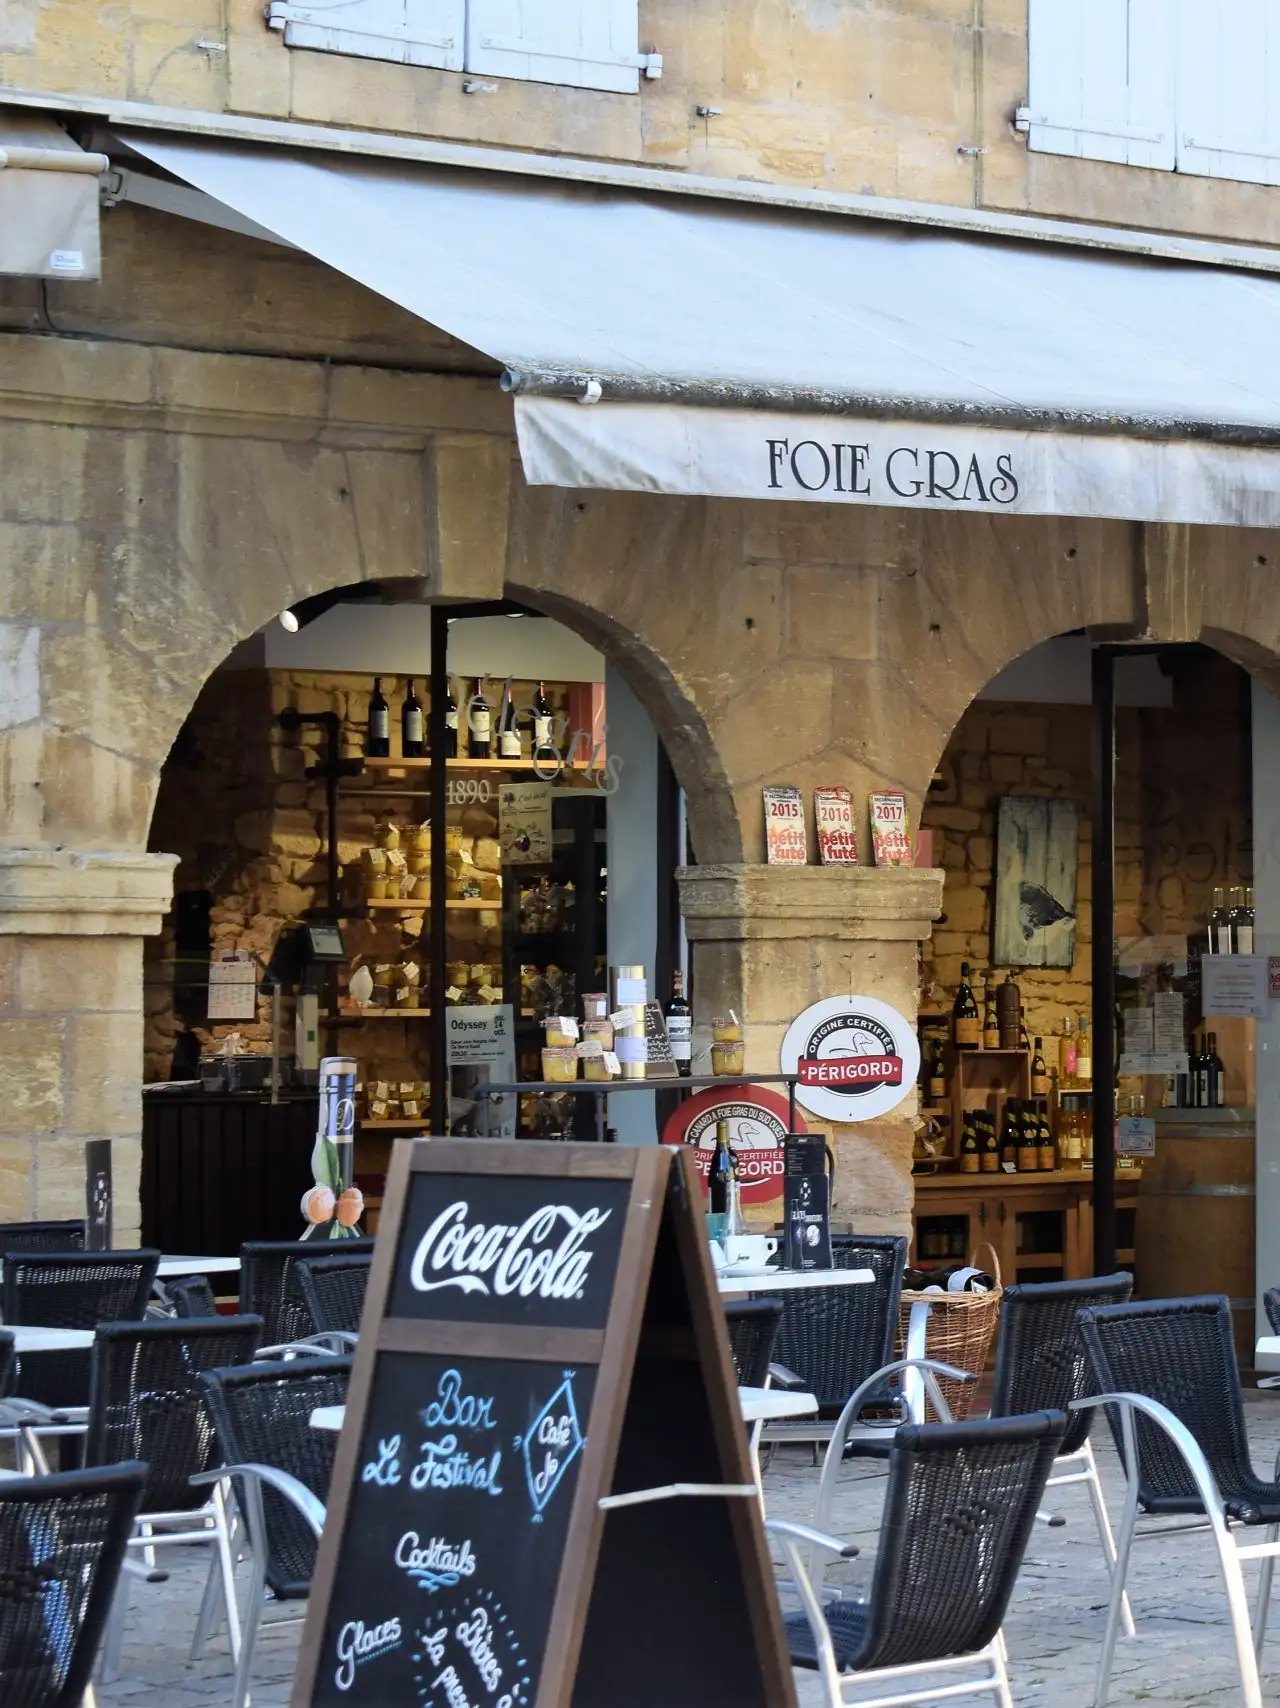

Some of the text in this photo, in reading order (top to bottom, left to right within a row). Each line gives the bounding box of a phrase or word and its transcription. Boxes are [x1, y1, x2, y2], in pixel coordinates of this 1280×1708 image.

[766, 437, 1018, 503] FOIE GRAS
[446, 779, 491, 805] 1890
[771, 802, 798, 817] 2015
[821, 807, 850, 822] 2016
[876, 805, 903, 820] 2017
[828, 845, 858, 860] futé
[451, 1020, 488, 1031] Odyssey
[809, 1018, 893, 1054] ORIGINE CERTIFIÉE
[807, 1061, 893, 1081] PÉRIGORD
[690, 1114, 712, 1138] CANARD
[717, 1107, 732, 1118] FOIE
[732, 1106, 749, 1116] GRAS
[748, 1108, 759, 1119] DU
[757, 1111, 772, 1125] SUD
[769, 1120, 785, 1140] OUEST
[737, 1150, 784, 1160] CERTIFIÉE
[410, 1201, 613, 1298] Coca-Cola
[424, 1368, 498, 1428] Bar
[538, 1415, 576, 1446] Café
[362, 1433, 504, 1496] Le Festival
[534, 1451, 560, 1494] Jo
[395, 1531, 477, 1577] Cocktails
[455, 1607, 504, 1693] Bières
